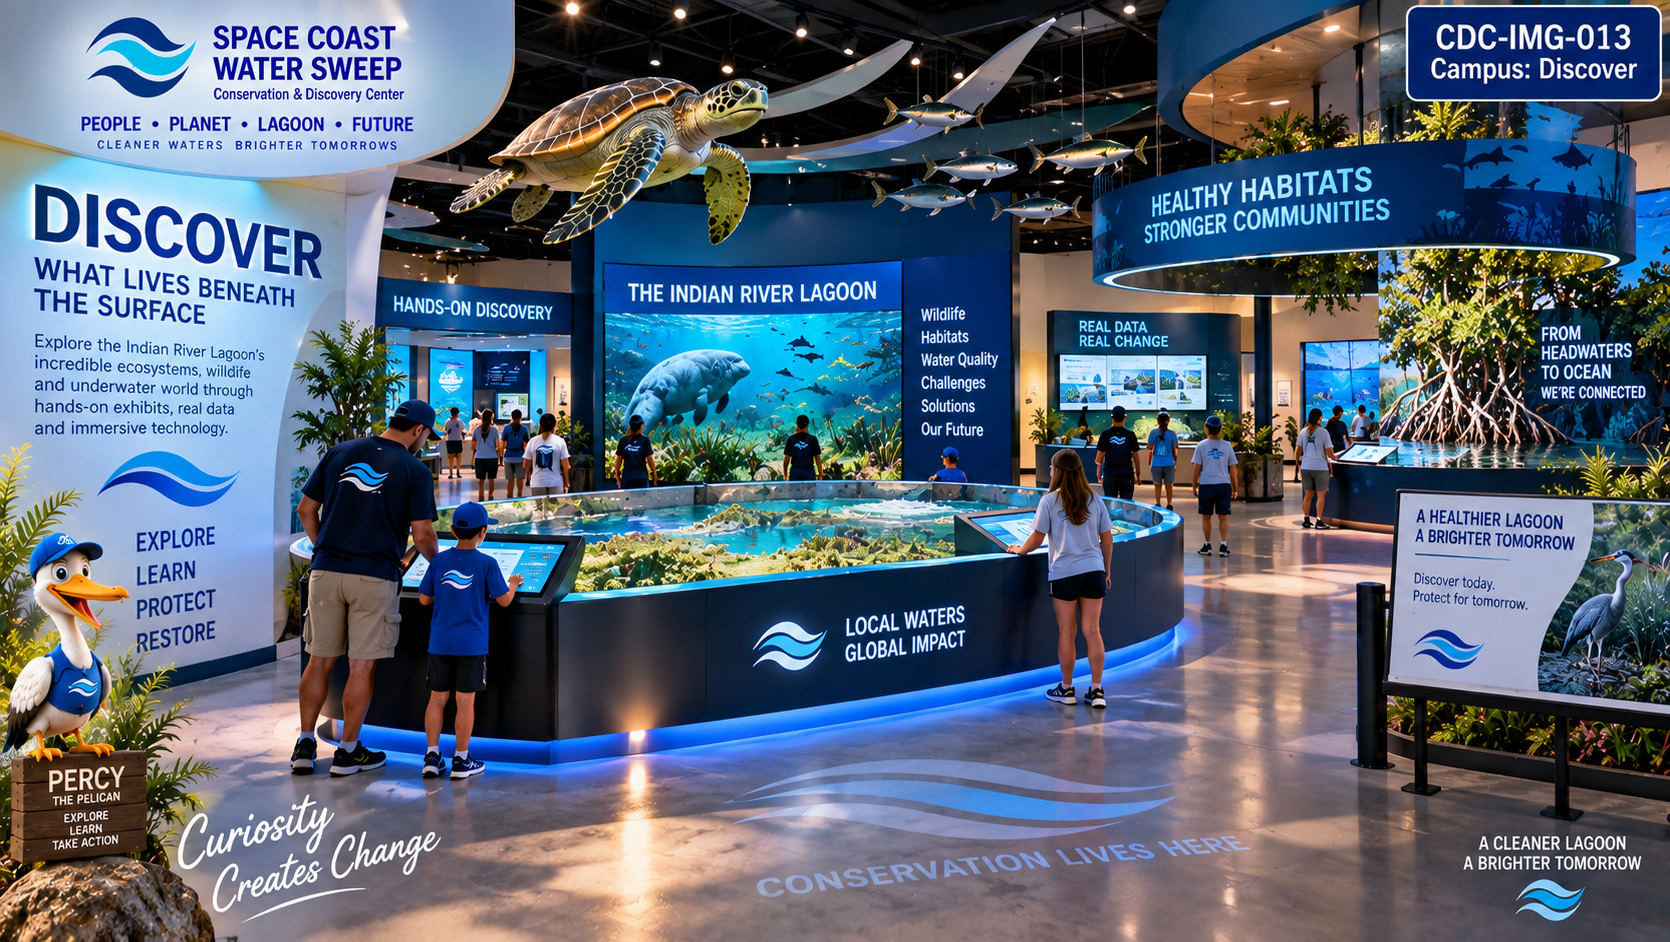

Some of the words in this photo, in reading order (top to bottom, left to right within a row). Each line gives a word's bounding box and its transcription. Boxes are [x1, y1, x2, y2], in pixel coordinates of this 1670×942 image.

[213, 25, 299, 50] SPACE
[307, 25, 396, 50] COAST
[213, 56, 304, 81] WATER
[311, 56, 401, 81] SWEEP
[213, 87, 289, 101] Conservation
[293, 88, 302, 100] &
[306, 87, 362, 103] Discovery
[366, 87, 404, 101] Center
[80, 116, 141, 131] PEOPLE
[169, 116, 231, 131] PLANET
[258, 116, 325, 132] LAGOON
[352, 117, 413, 132] FUTURE
[97, 140, 160, 150] CLEANER
[168, 140, 223, 150] WATERS
[235, 140, 302, 150] BRIGHTER
[311, 141, 397, 150] TOMORROWS
[1151, 181, 1233, 217] HEALTHY
[1241, 166, 1372, 203] HABITATS
[1144, 212, 1227, 244] STRONGER
[1233, 198, 1390, 232] COMMUNITIES
[34, 184, 323, 280] DISCOVER
[34, 256, 115, 286] WHAT
[124, 268, 190, 296] LIVES
[198, 277, 295, 308] BENEATH
[628, 283, 664, 302] THE
[670, 284, 733, 304] INDIAN
[741, 284, 794, 303] RIVER
[800, 281, 877, 302] LAGOON
[34, 288, 88, 314] THE
[98, 294, 206, 325] SURFACE
[393, 295, 471, 316] HANDS-ON
[476, 302, 553, 320] DISCOVERY
[921, 306, 966, 321] Wildlife
[1079, 320, 1111, 333] REAL
[1115, 321, 1148, 333] DATA
[1541, 325, 1581, 341] FROM
[35, 333, 92, 351] Explore
[97, 338, 121, 352] the
[127, 340, 169, 355] Indian
[174, 343, 206, 357] River
[921, 330, 969, 344] Habitats
[1079, 335, 1111, 347] REAL
[1115, 335, 1169, 347] CHANGE
[921, 353, 955, 366] Water
[958, 352, 998, 368] Quality
[1541, 343, 1633, 360] HEADWATERS
[35, 355, 112, 372] incredible
[117, 361, 202, 378] ecosystems,
[1541, 365, 1560, 379] TO
[1564, 363, 1611, 379] OCEAN
[34, 377, 64, 392] and
[71, 379, 156, 394] underwater
[161, 382, 198, 395] world
[203, 383, 253, 399] through
[921, 375, 986, 392] Challenges
[1579, 386, 1646, 399] CONNECTED
[35, 399, 108, 413] hands-on
[114, 400, 173, 416] exhibits,
[178, 402, 202, 414] real
[207, 402, 235, 415] data
[921, 398, 975, 413] Solutions
[34, 421, 64, 435] and
[71, 421, 146, 434] immersive
[152, 421, 229, 437] technology.
[921, 422, 942, 436] Our
[946, 422, 984, 437] Future
[1416, 509, 1425, 523] A
[1430, 509, 1500, 526] HEALTHIER
[1506, 513, 1563, 530] LAGOON
[137, 526, 215, 552] EXPLORE
[1415, 528, 1424, 542] A
[1428, 529, 1491, 546] BRIGHTER
[1495, 533, 1575, 550] TOMORROW
[137, 560, 196, 586] LEARN
[1414, 572, 1459, 587] Discover
[1463, 576, 1495, 592] today.
[137, 589, 216, 620] PROTECT
[1413, 590, 1450, 603] Protect
[1454, 592, 1469, 605] for
[1472, 595, 1528, 610] tomorrow.
[845, 613, 900, 637] LOCAL
[904, 605, 965, 629] WATERS
[136, 620, 216, 654] RESTORE
[845, 637, 907, 663] GLOBAL
[912, 630, 966, 654] IMPACT
[48, 766, 125, 793] PERCY
[53, 795, 73, 806] THE
[77, 792, 120, 804] PELICAN
[64, 810, 109, 823] EXPLORE
[70, 824, 102, 835] LEARN
[52, 838, 78, 850] TAKE
[81, 835, 119, 847] ACTION
[756, 850, 1051, 898] CONSERVATION
[1055, 842, 1155, 866] LIVES
[1157, 835, 1251, 858] HERE
